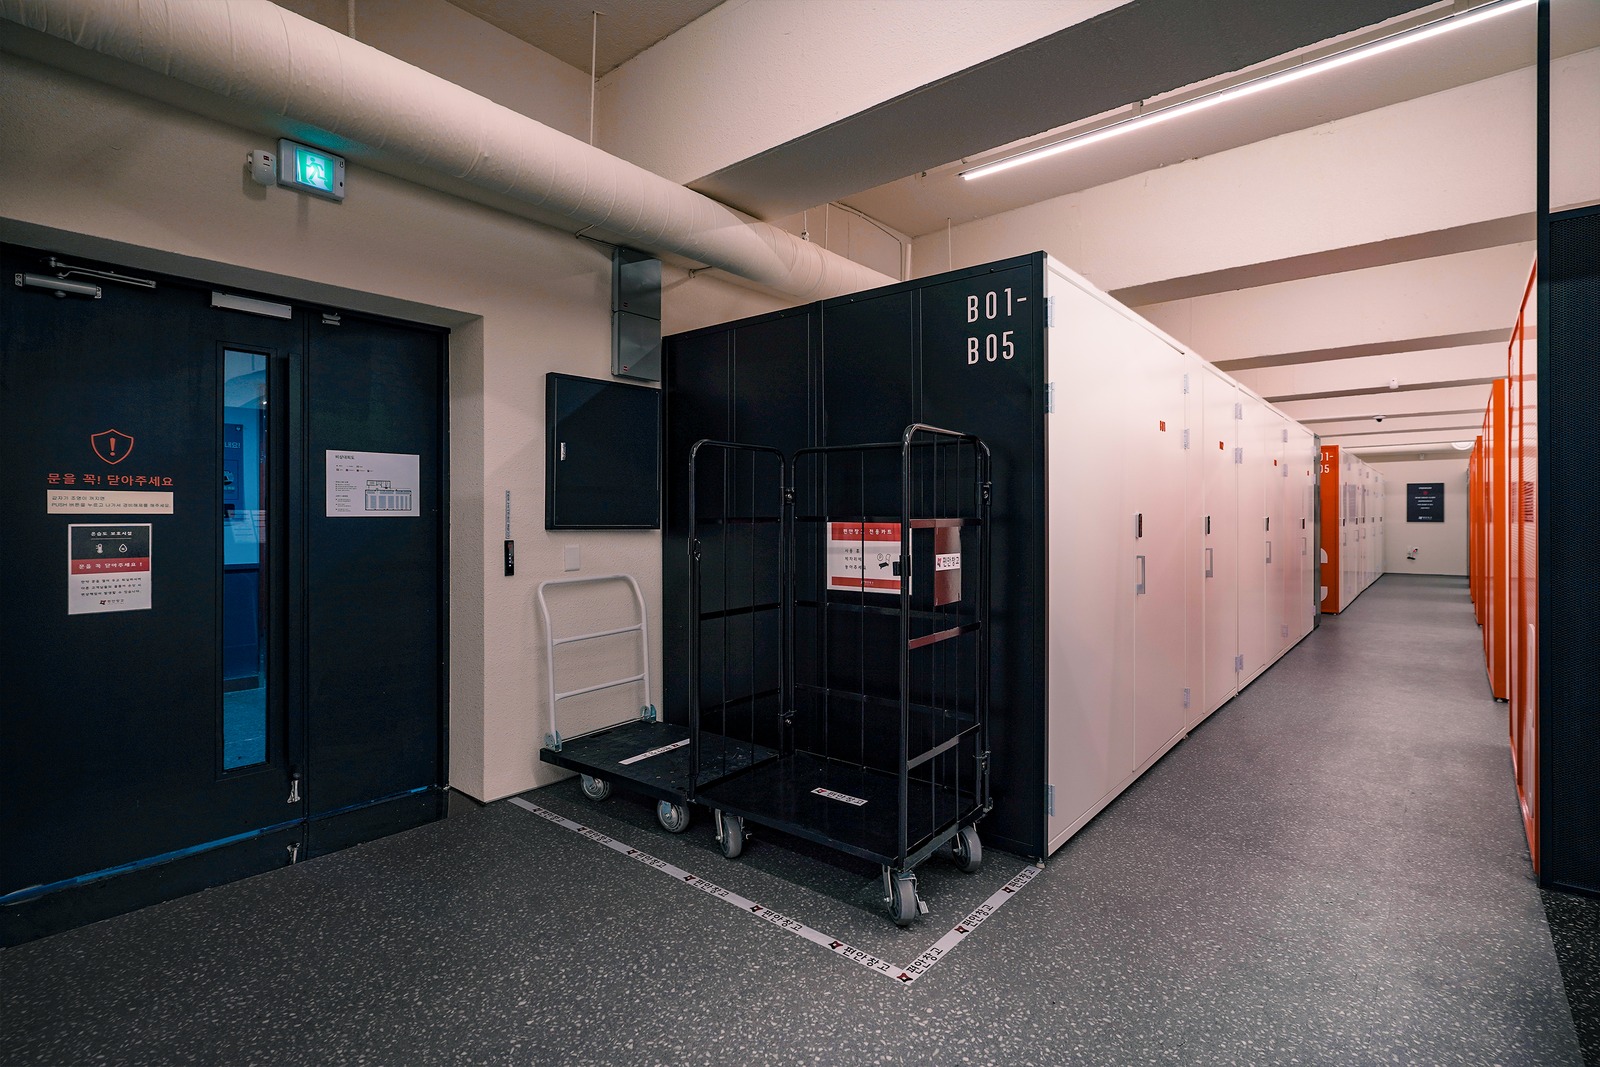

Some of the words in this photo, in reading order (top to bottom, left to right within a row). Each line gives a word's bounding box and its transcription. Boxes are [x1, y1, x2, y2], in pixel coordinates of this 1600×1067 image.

[967, 287, 1027, 323] B01-
[967, 330, 1015, 365] B05
[47, 473, 76, 485] 문을
[82, 474, 101, 486] 꼭!
[107, 474, 174, 487] 닫아주세요
[942, 556, 960, 568] 편안창고
[693, 879, 730, 898] 편안창고
[1008, 869, 1036, 889] 편안창고
[762, 909, 803, 932] 편안창고
[962, 904, 994, 928] 편안창고
[842, 946, 892, 973] 편안창고
[907, 947, 944, 974] 편안창고
